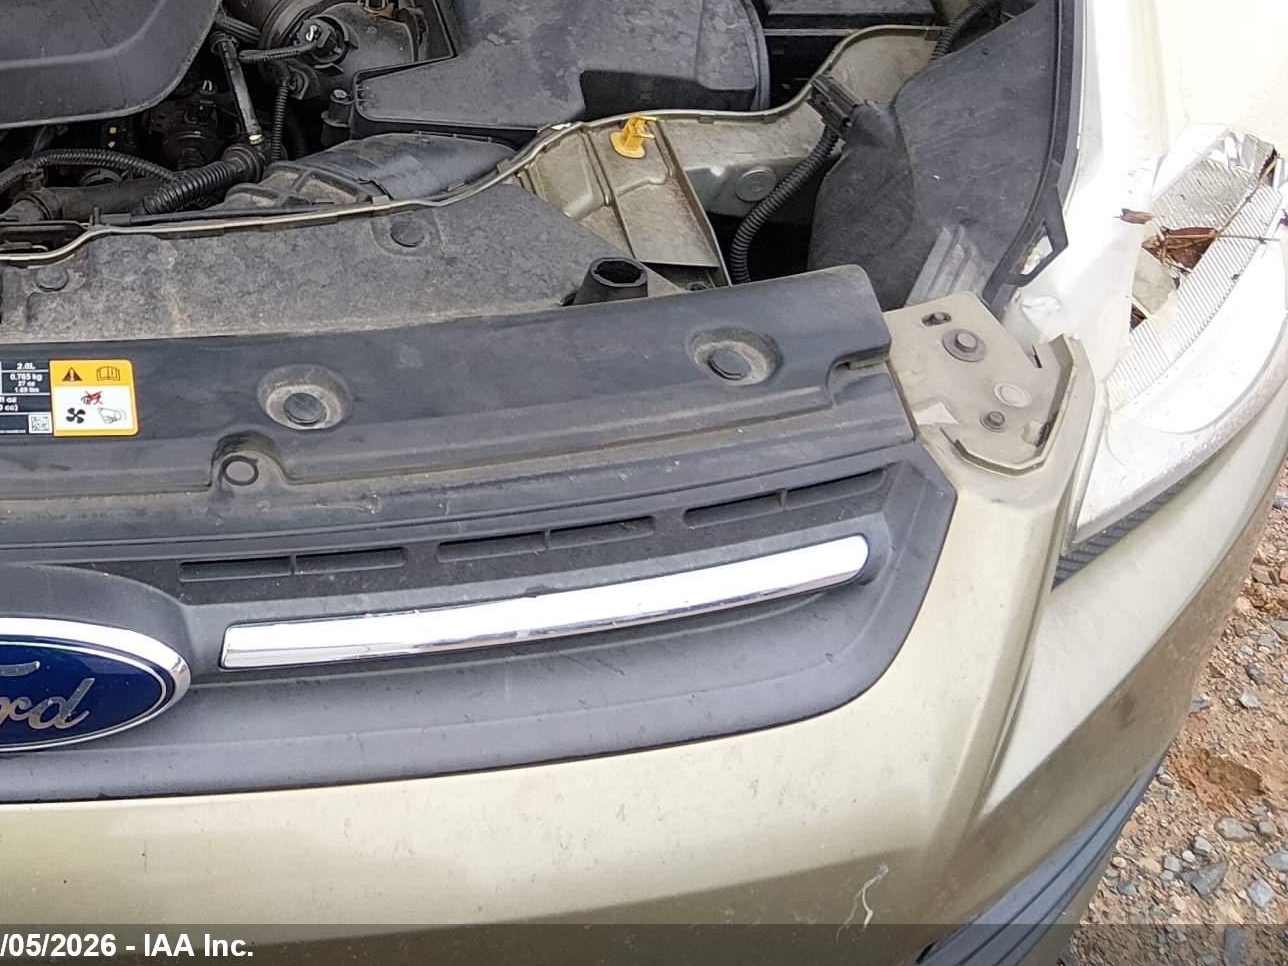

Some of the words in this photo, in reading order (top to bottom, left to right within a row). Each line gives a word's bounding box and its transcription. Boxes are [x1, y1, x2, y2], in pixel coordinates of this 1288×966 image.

[16, 362, 36, 370] 2.0L
[32, 373, 43, 382] kg
[4, 404, 18, 412] cc)
